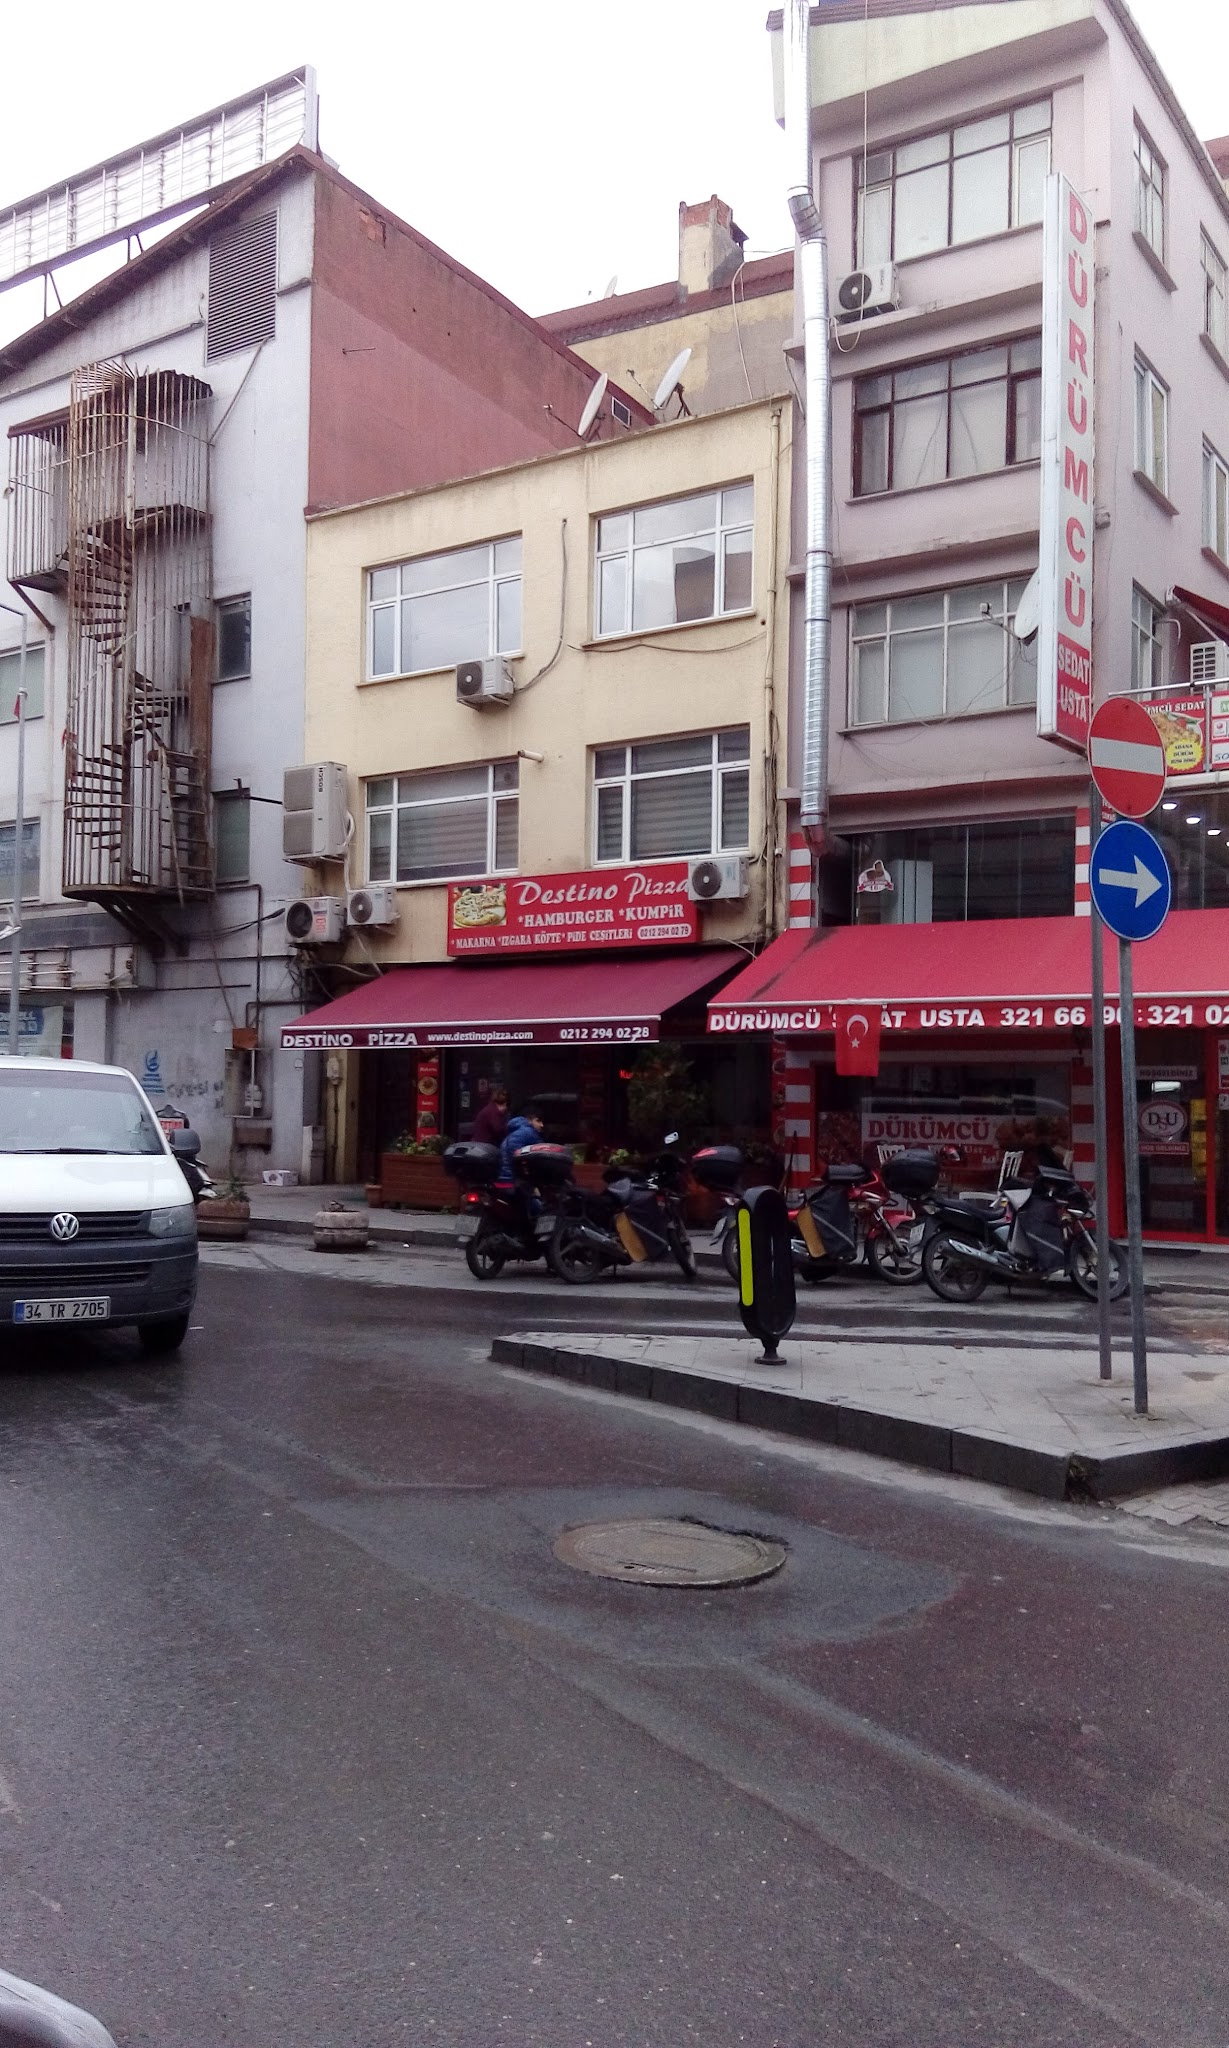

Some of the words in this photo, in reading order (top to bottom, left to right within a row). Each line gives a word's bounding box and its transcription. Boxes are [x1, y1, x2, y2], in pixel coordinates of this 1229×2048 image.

[1065, 190, 1088, 628] DÜRÜMCÜ
[1058, 643, 1090, 685] SEDAT
[1060, 684, 1087, 722] USTA
[1174, 701, 1205, 712] SEDAT
[513, 881, 618, 906] Destino
[624, 872, 688, 903] Pizza
[710, 1008, 821, 1031] DÜRÜMCÜ
[920, 1009, 985, 1027] USTA
[1000, 1007, 1044, 1026] 321
[1054, 1007, 1086, 1026] 66
[560, 1028, 589, 1039] 0212
[591, 1027, 613, 1039] 294
[868, 1115, 991, 1140] DÜRÜMCÜ
[25, 1304, 42, 1319] 34
[49, 1303, 66, 1318] TR
[73, 1301, 105, 1317] 2705
